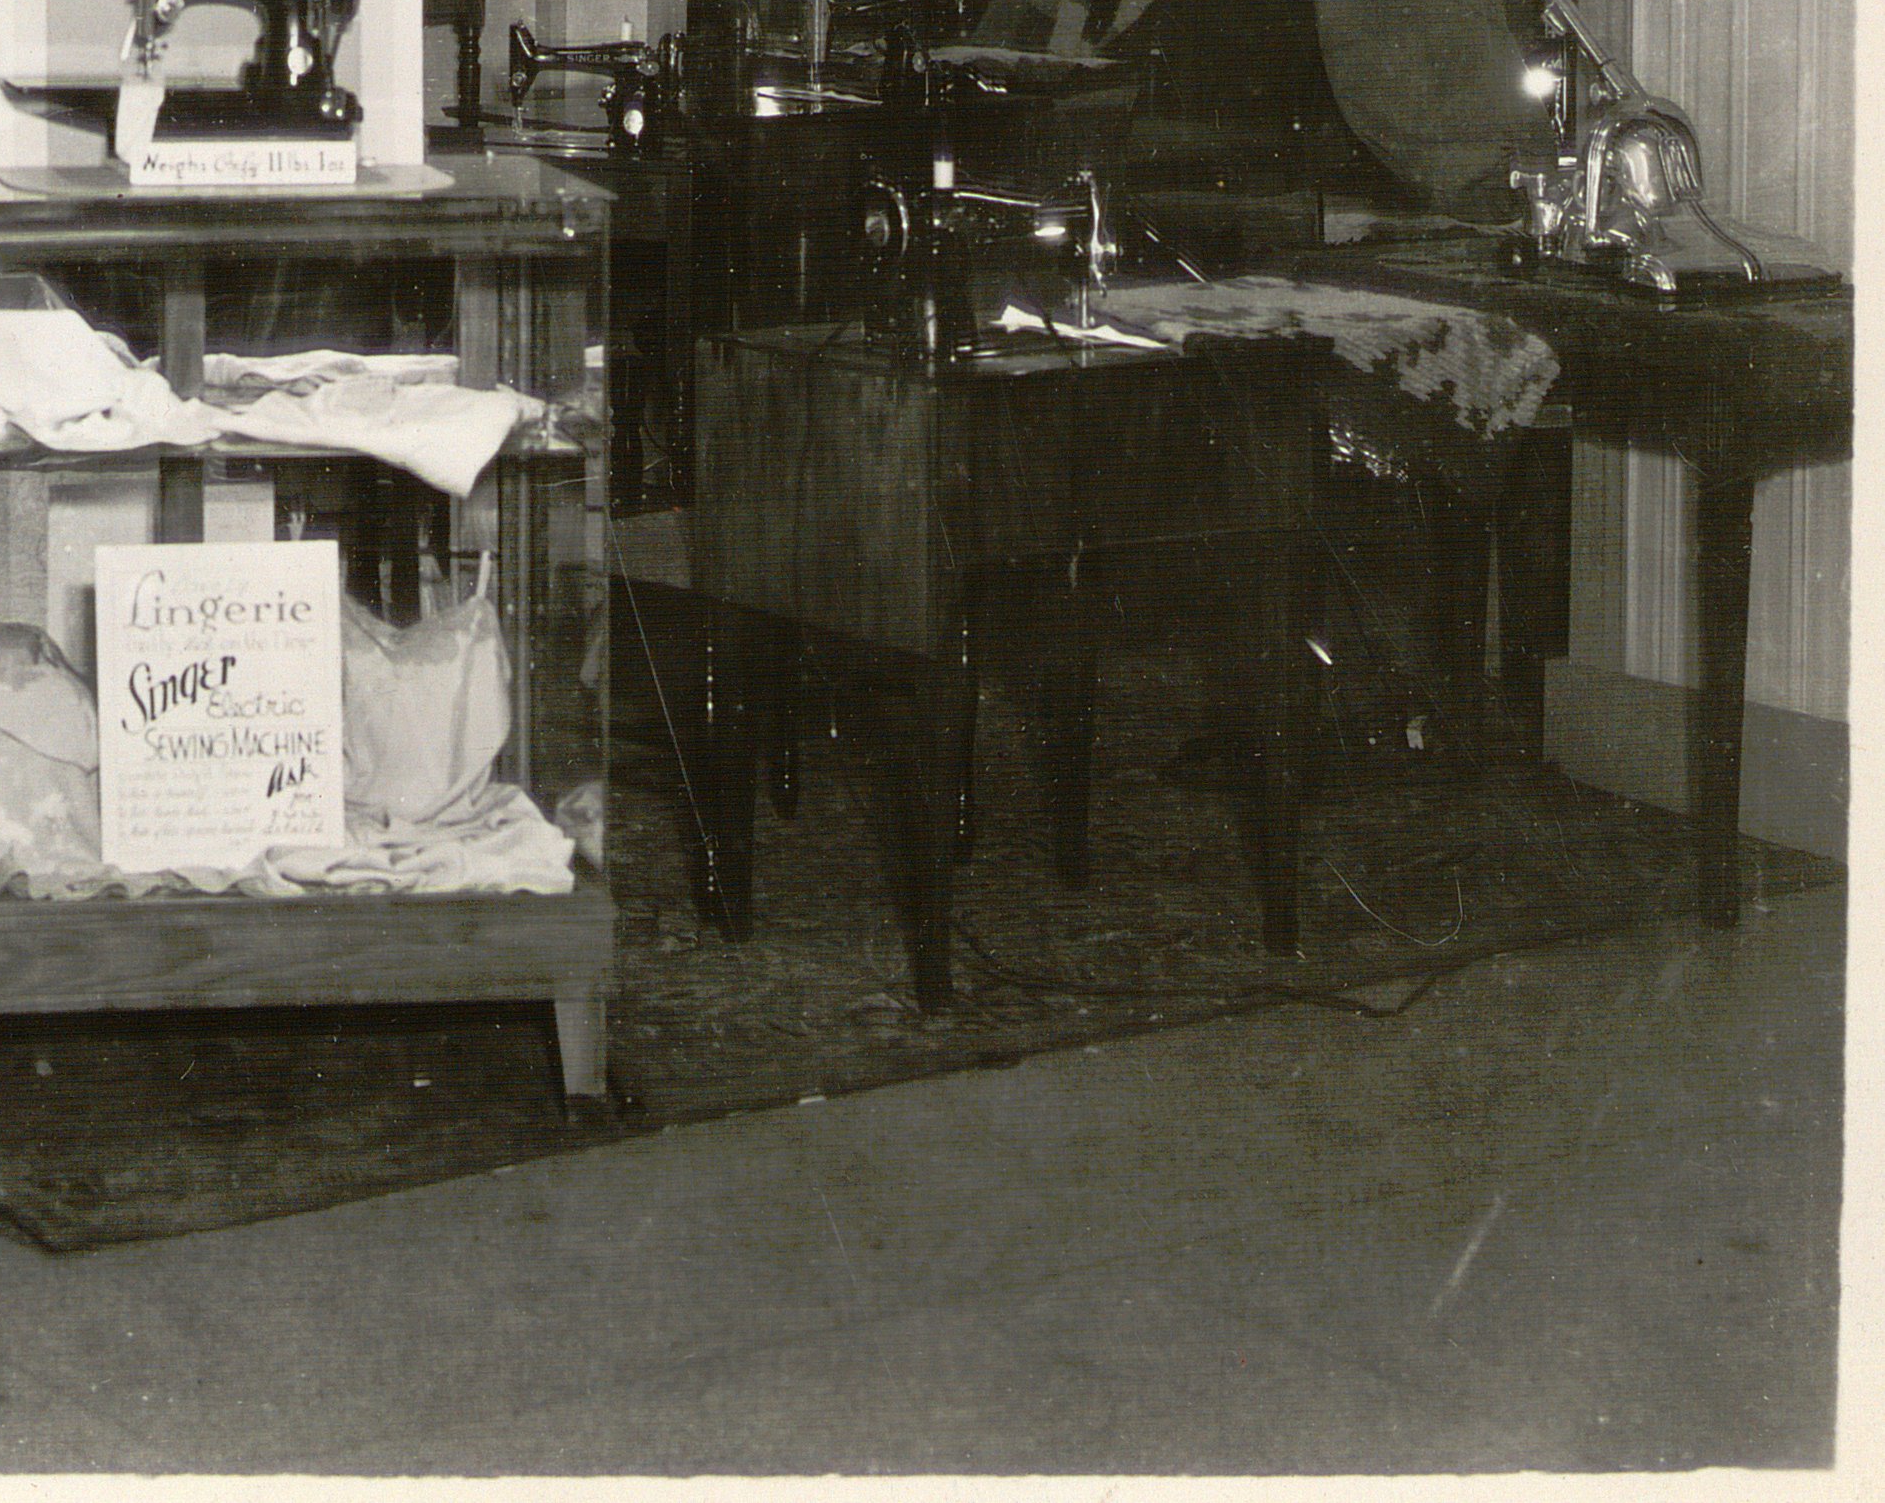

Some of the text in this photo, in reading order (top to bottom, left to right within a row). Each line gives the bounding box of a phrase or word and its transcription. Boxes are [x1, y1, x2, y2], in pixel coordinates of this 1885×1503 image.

[566, 53, 611, 64] SINGER
[124, 569, 314, 634] Lingerie
[121, 655, 237, 735] Singer
[206, 689, 305, 720] Electric
[144, 726, 328, 761] SEWING MACHINE
[266, 756, 319, 799] Ask
